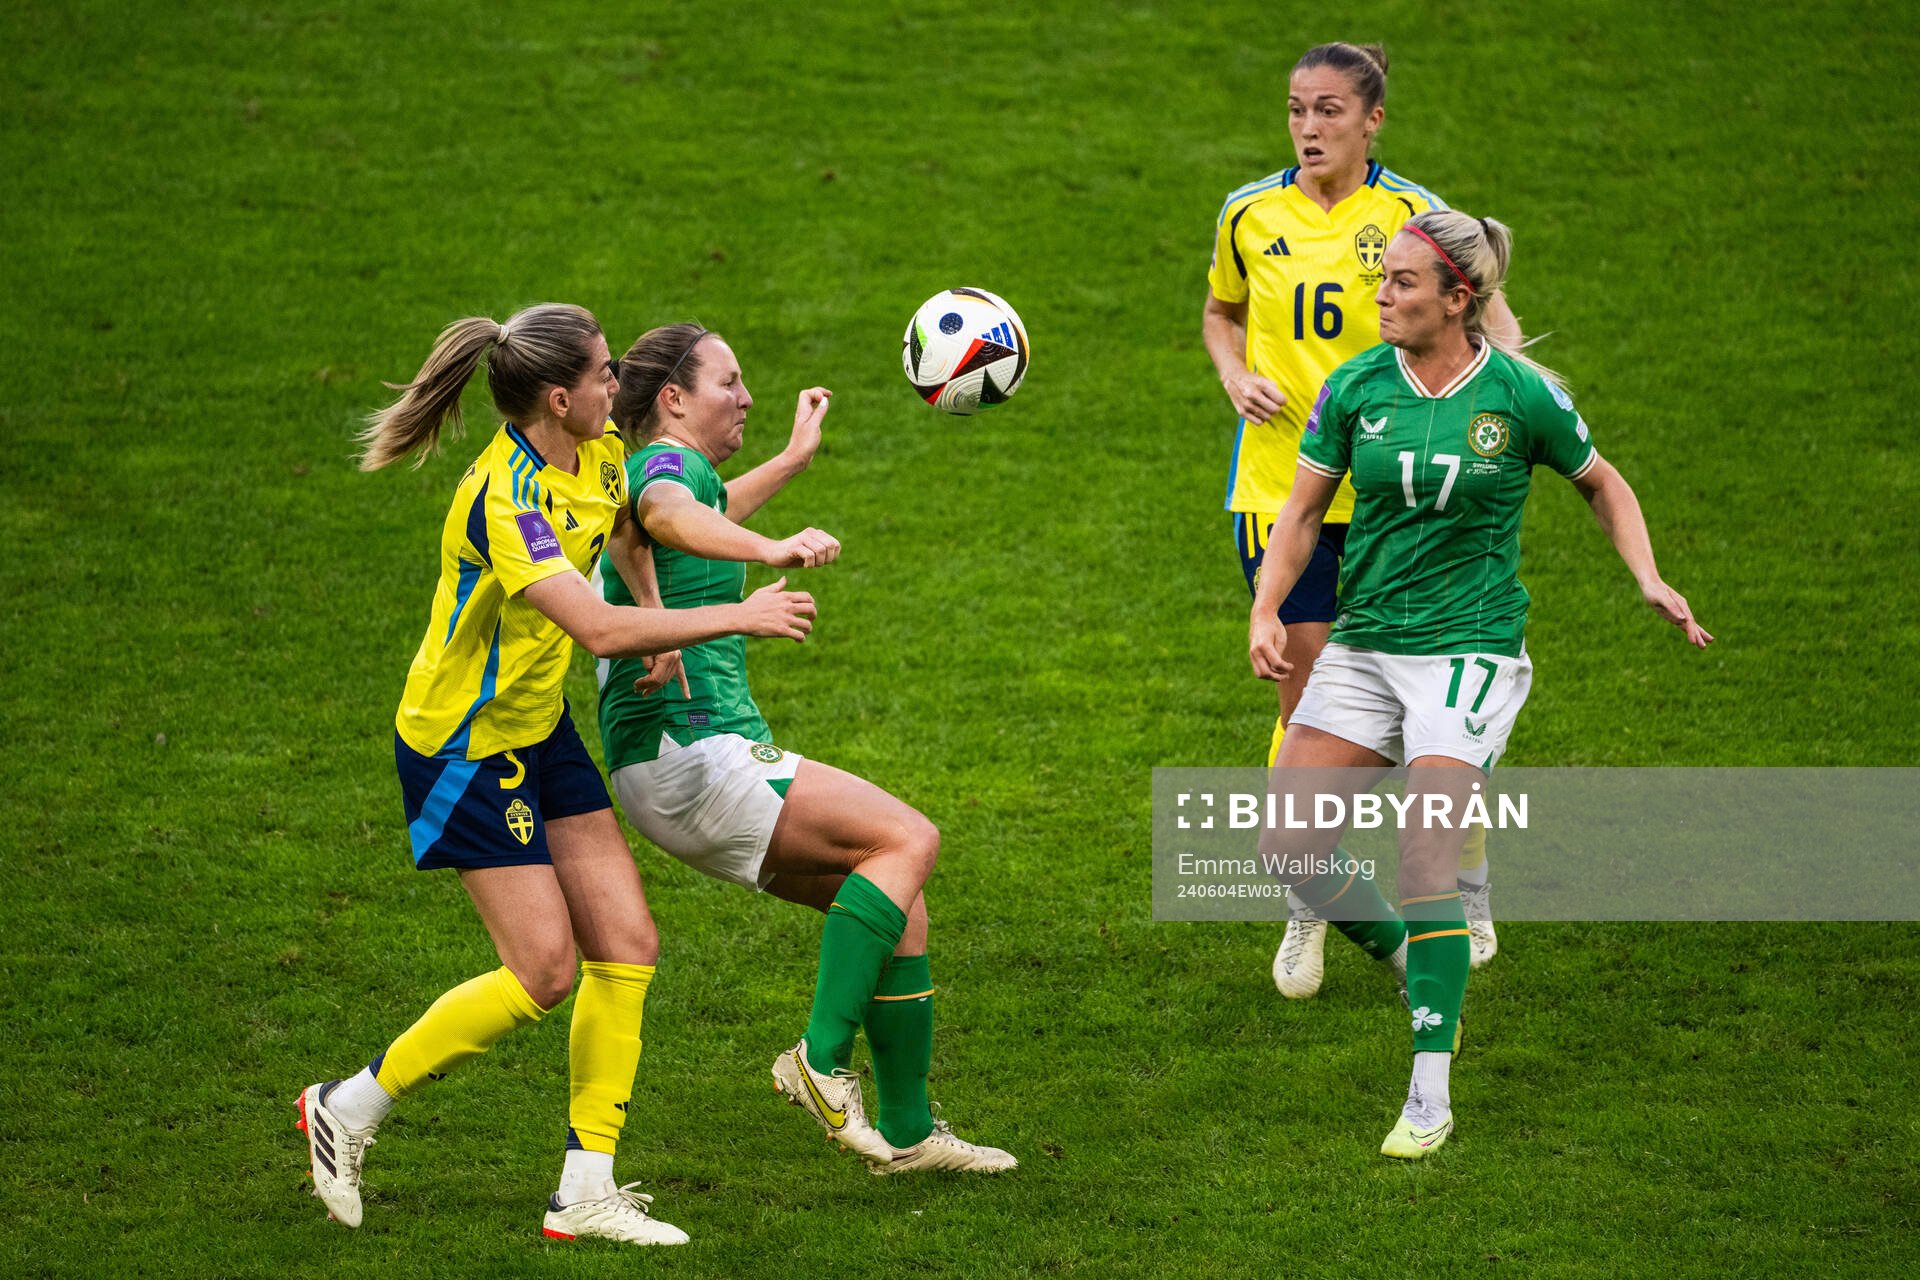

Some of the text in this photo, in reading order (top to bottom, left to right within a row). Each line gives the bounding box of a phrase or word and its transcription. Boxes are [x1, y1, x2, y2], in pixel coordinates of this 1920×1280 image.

[1294, 282, 1344, 340] 16
[1397, 450, 1461, 512] 17
[1445, 656, 1498, 714] 17
